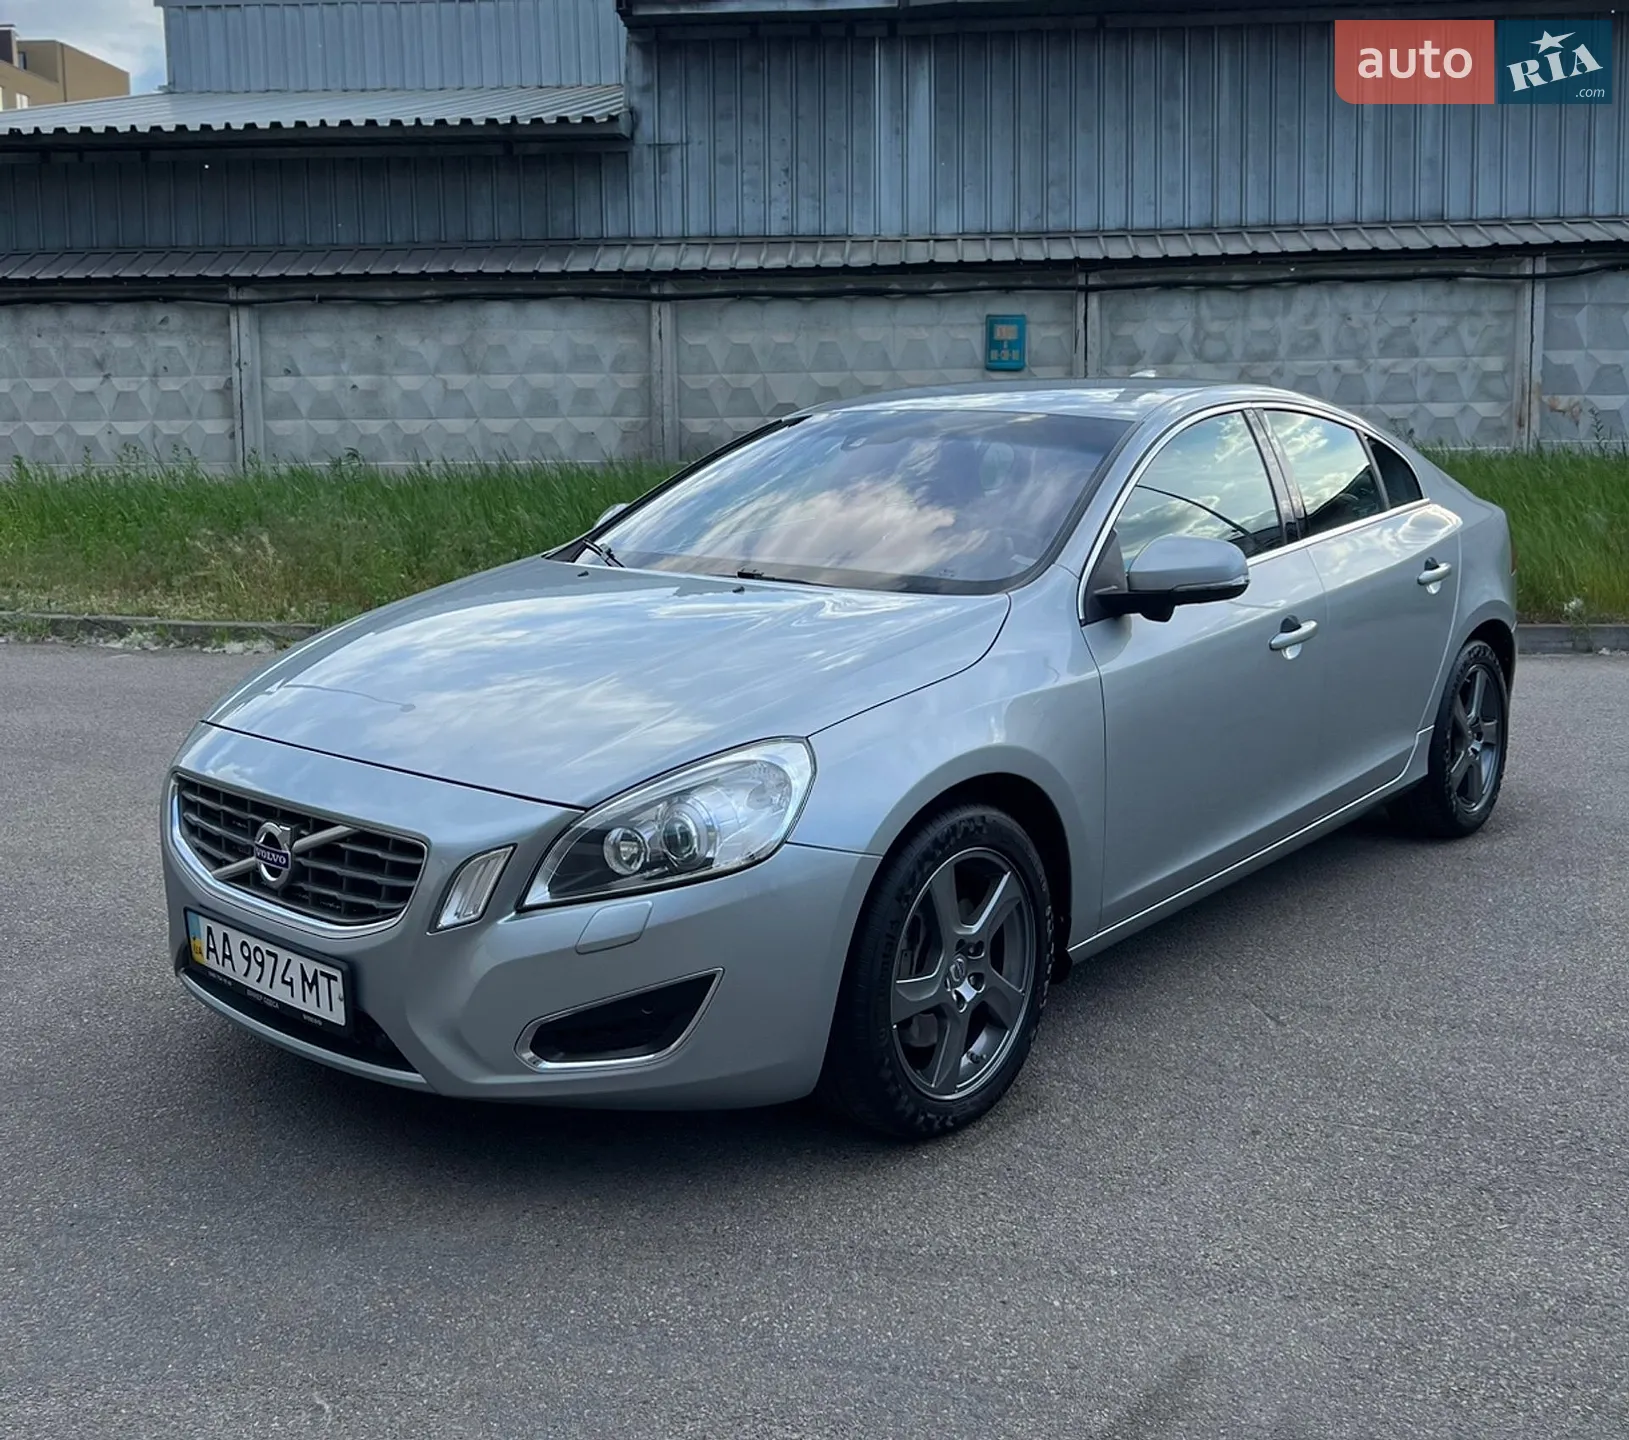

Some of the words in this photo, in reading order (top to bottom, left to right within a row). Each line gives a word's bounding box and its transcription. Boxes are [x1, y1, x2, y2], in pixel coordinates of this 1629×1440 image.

[256, 847, 287, 865] VOLVO
[206, 925, 236, 973] AA
[239, 940, 294, 998] 9974
[300, 962, 338, 1012] MT
